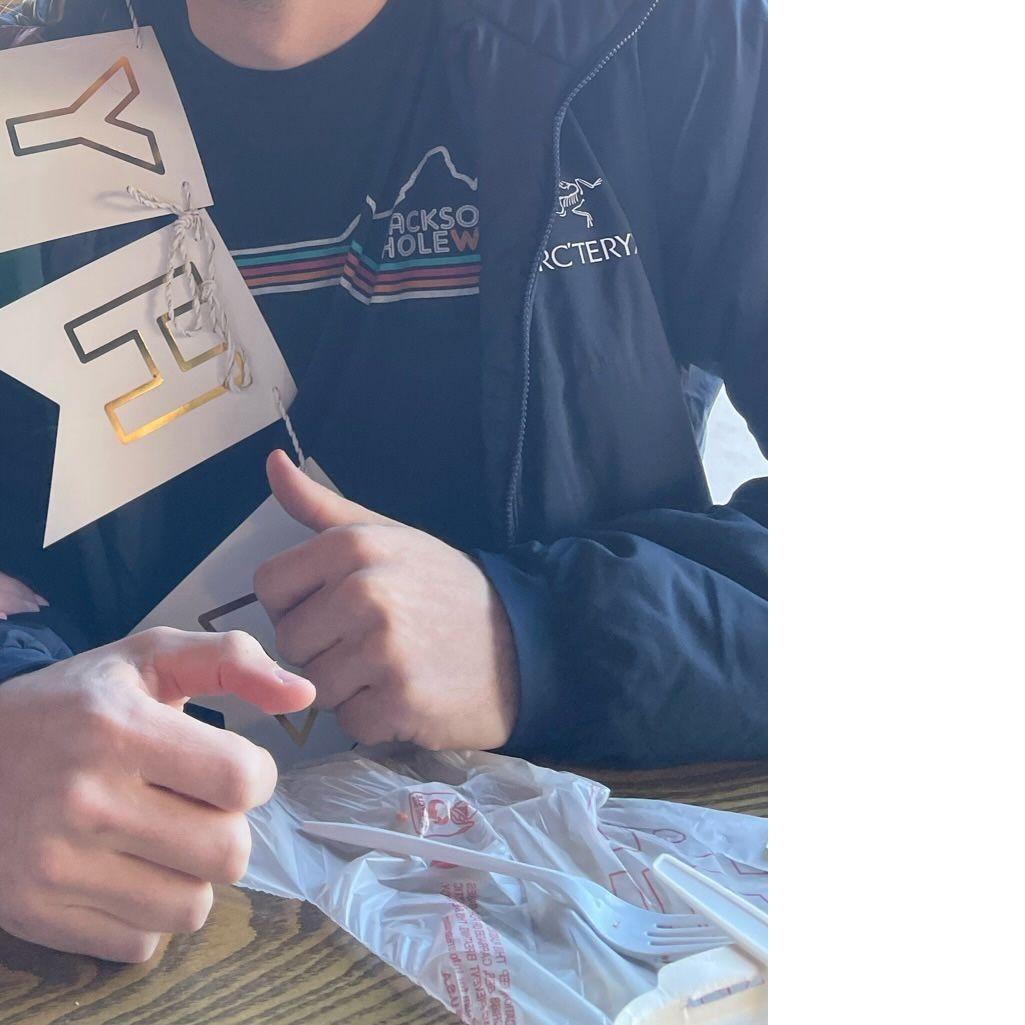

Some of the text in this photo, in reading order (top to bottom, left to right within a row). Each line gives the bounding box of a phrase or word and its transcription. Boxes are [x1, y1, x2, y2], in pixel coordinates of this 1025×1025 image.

[5, 56, 165, 175] Y
[389, 205, 480, 236] ACKSO
[539, 233, 638, 271] RC'TERY
[64, 262, 245, 445] H
